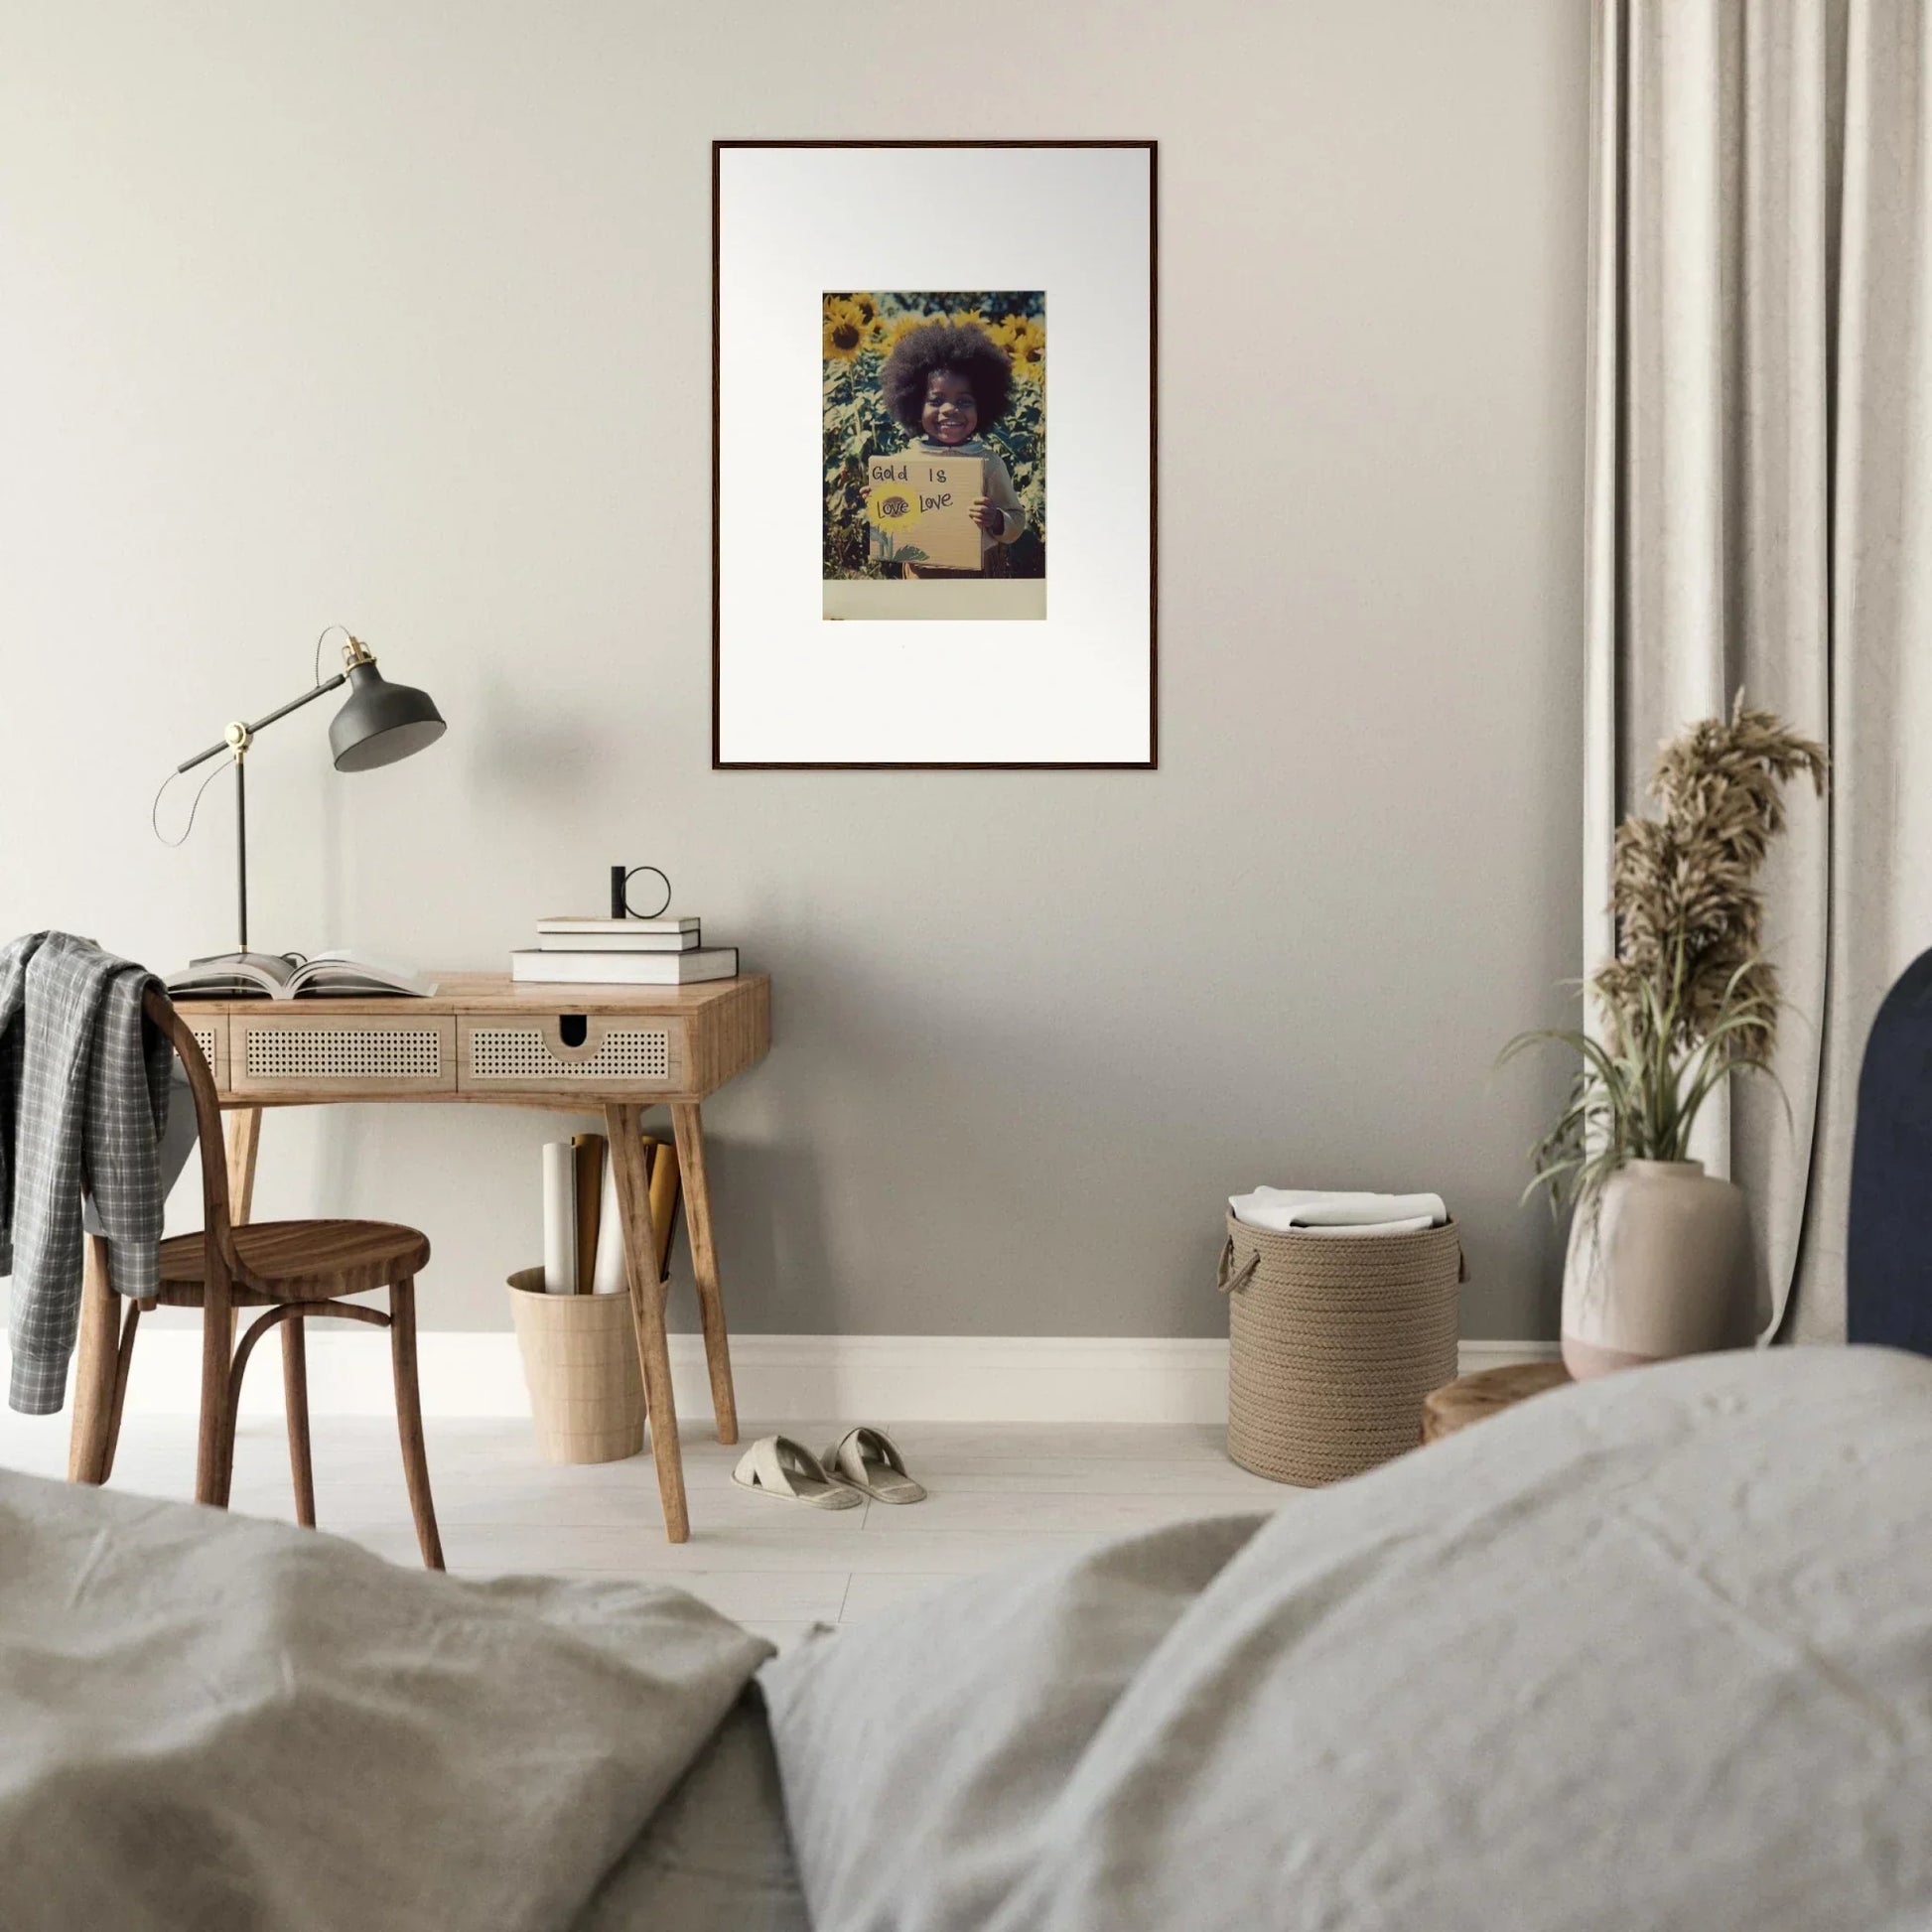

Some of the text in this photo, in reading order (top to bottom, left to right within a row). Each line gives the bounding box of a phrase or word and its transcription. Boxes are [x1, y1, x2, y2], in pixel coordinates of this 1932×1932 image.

[872, 465, 908, 482] Gold
[877, 492, 953, 519] Love Love
